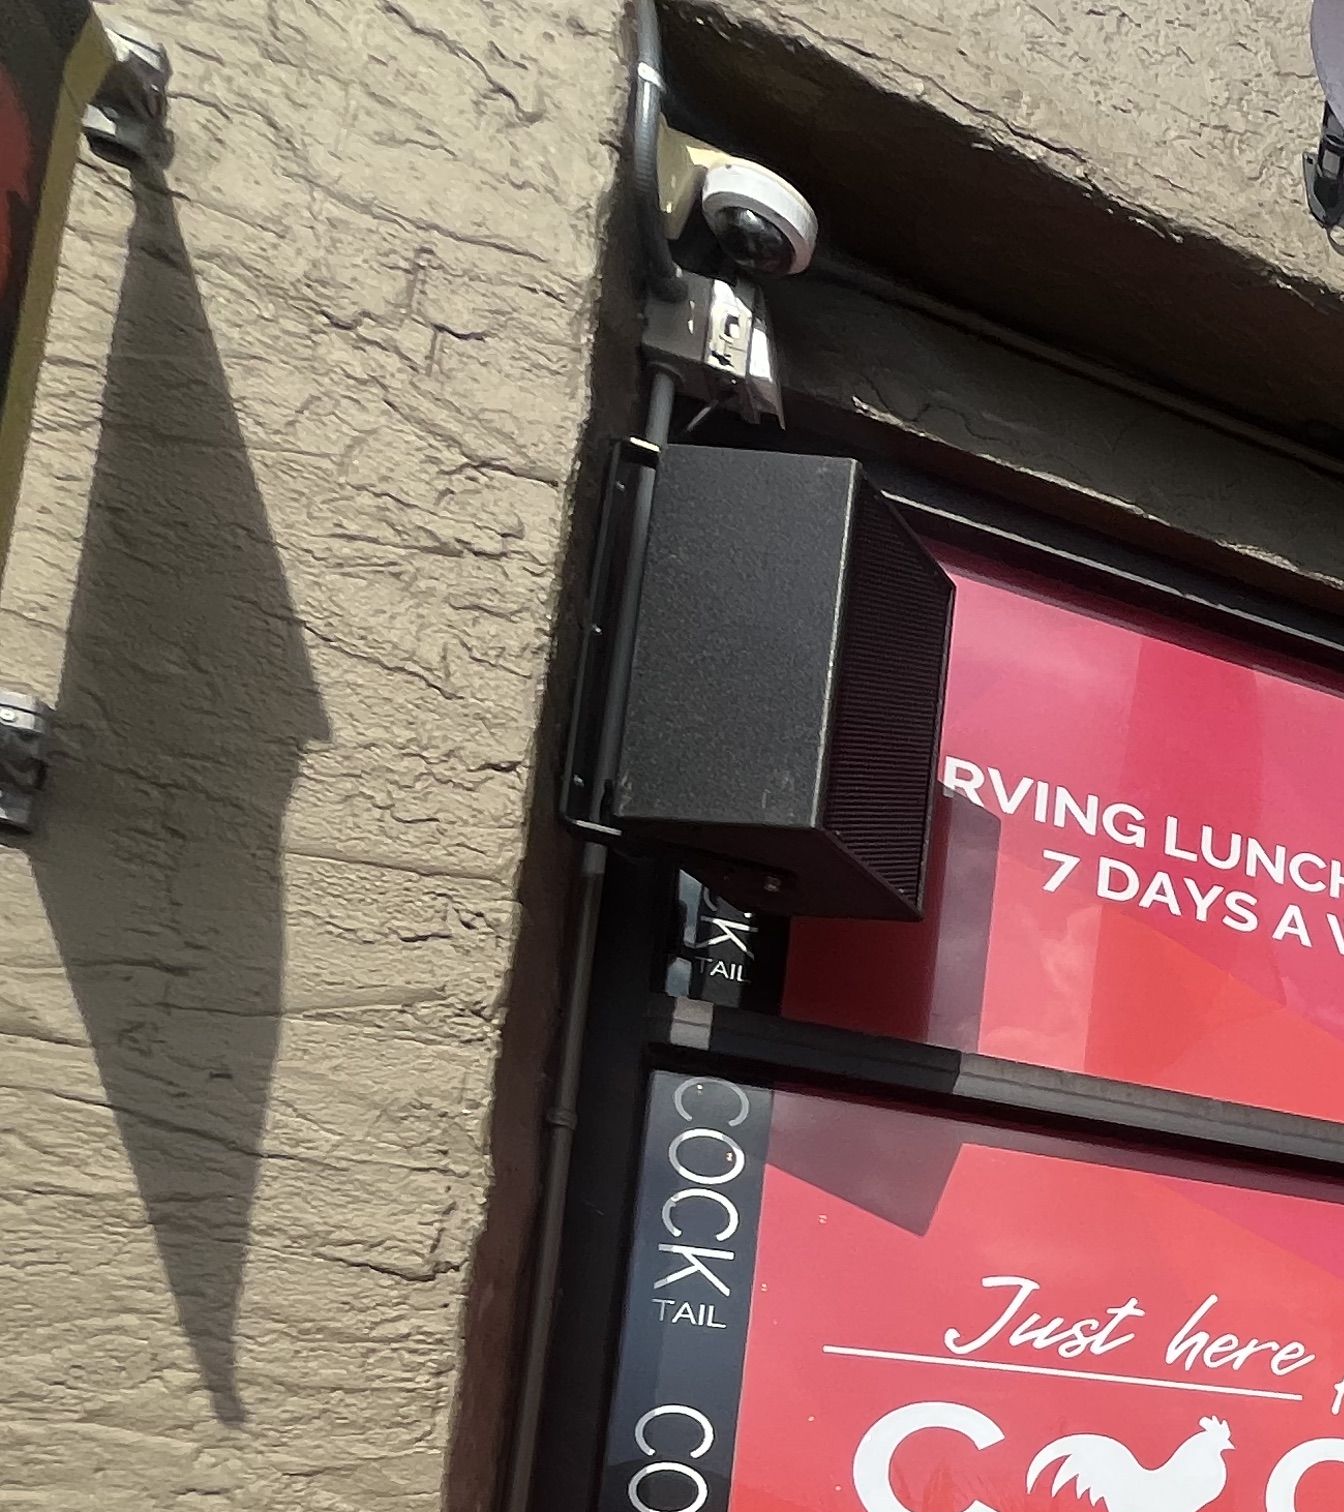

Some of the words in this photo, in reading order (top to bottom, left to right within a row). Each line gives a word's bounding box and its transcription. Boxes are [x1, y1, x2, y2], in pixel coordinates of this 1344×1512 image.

[1040, 849, 1081, 894] 7
[1097, 862, 1260, 934] DAYS
[1273, 909, 1311, 949] A
[695, 956, 750, 983] TAIL
[654, 1076, 750, 1297] COCK
[652, 1298, 727, 1329] TAIL
[945, 1275, 1146, 1356] Just
[1165, 1295, 1315, 1376] here
